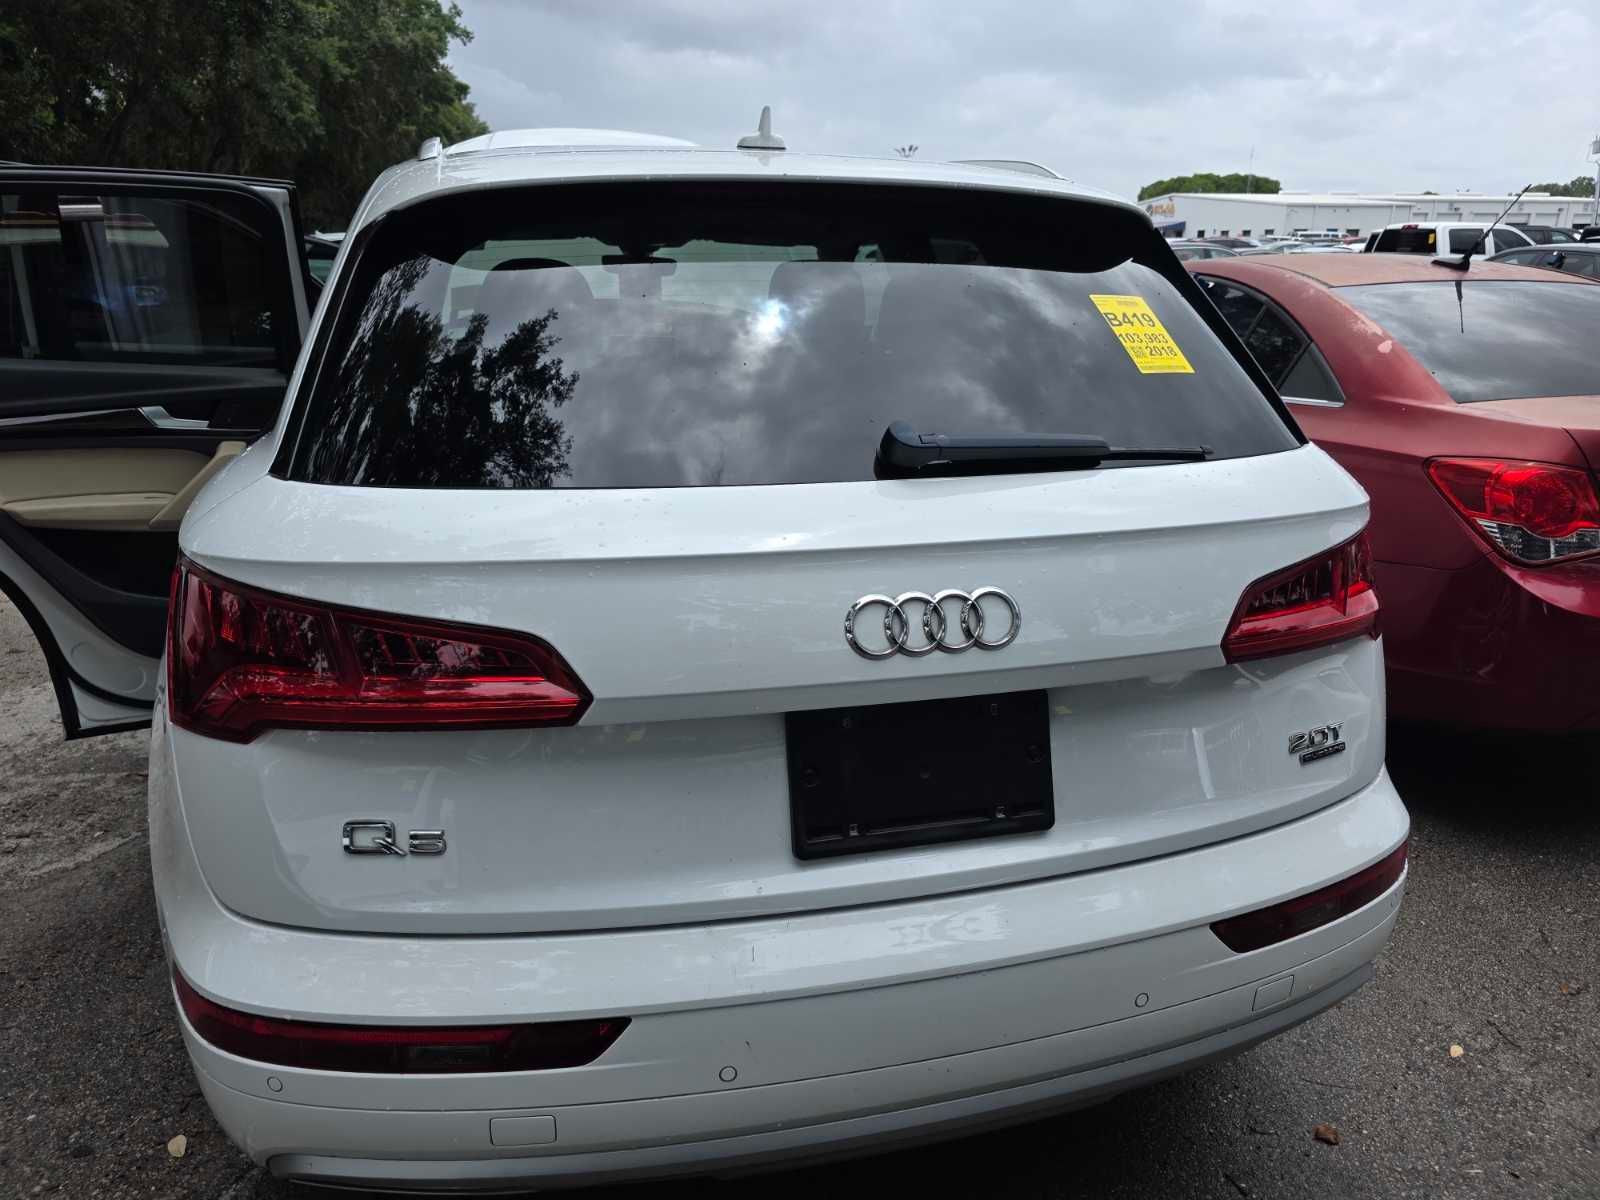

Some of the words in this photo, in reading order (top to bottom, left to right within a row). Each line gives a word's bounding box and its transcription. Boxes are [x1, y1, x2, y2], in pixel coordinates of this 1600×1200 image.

[1104, 312, 1156, 328] B419
[1145, 345, 1177, 357] 2018
[343, 819, 447, 857] Q5
